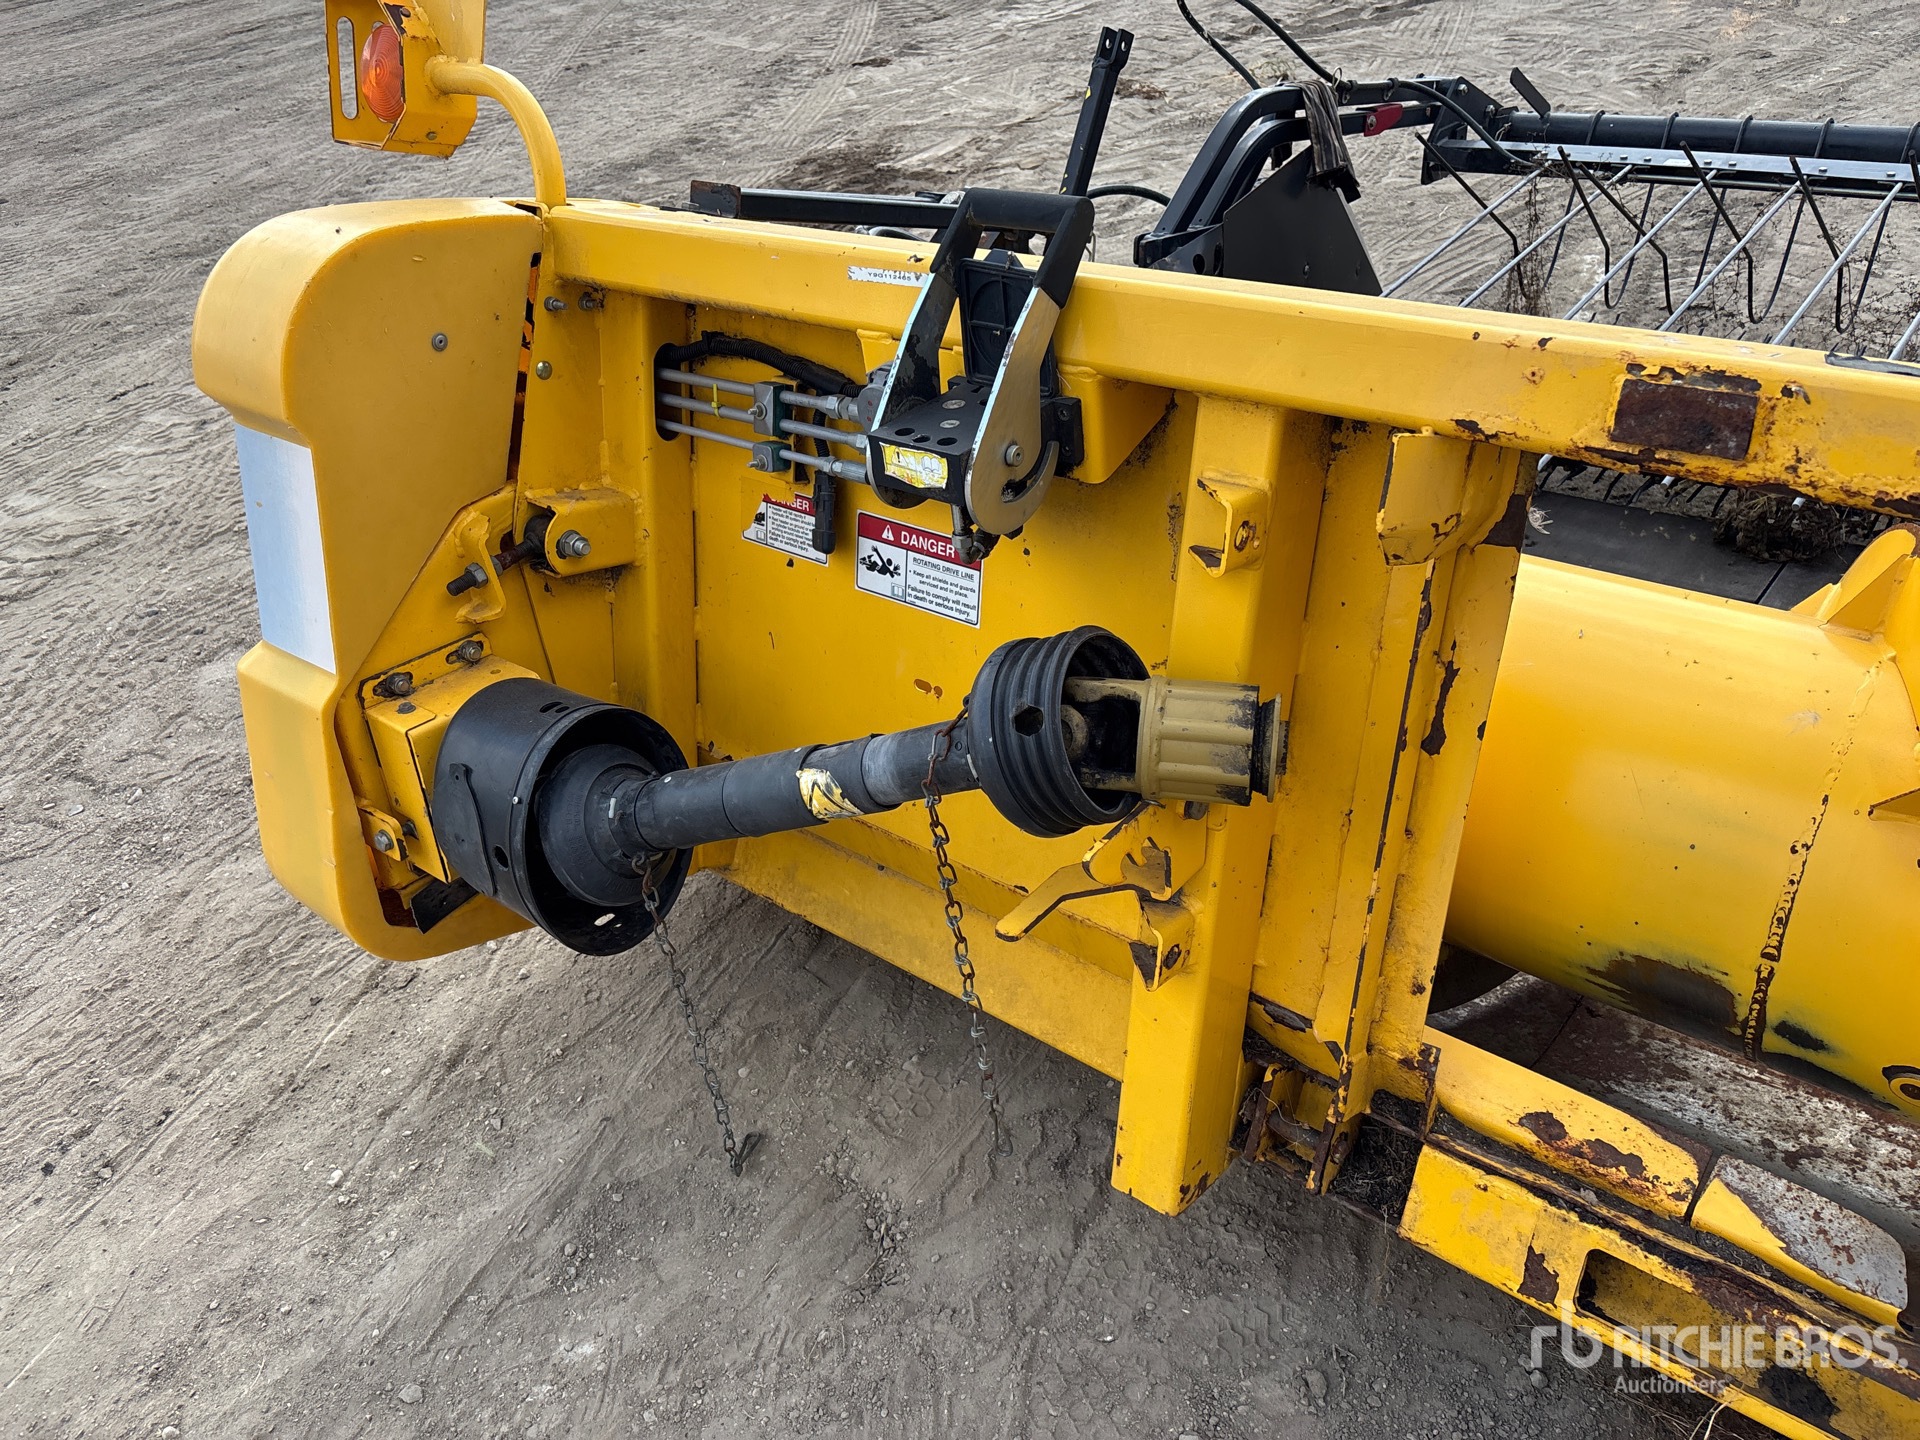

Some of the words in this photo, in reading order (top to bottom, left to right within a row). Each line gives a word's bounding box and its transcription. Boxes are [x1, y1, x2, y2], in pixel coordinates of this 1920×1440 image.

[901, 531, 955, 558] DANGER
[913, 557, 941, 571] ROTATING
[942, 566, 959, 576] DRIVE
[960, 571, 974, 581] LINE
[913, 570, 925, 578] Keep
[932, 575, 949, 585] shields
[959, 585, 976, 594] guards
[919, 580, 939, 589] serviced
[908, 584, 925, 595] Failure
[932, 593, 951, 604] comply
[951, 598, 960, 606] will
[961, 602, 976, 611] result
[913, 594, 928, 603] death
[934, 601, 954, 612] serious
